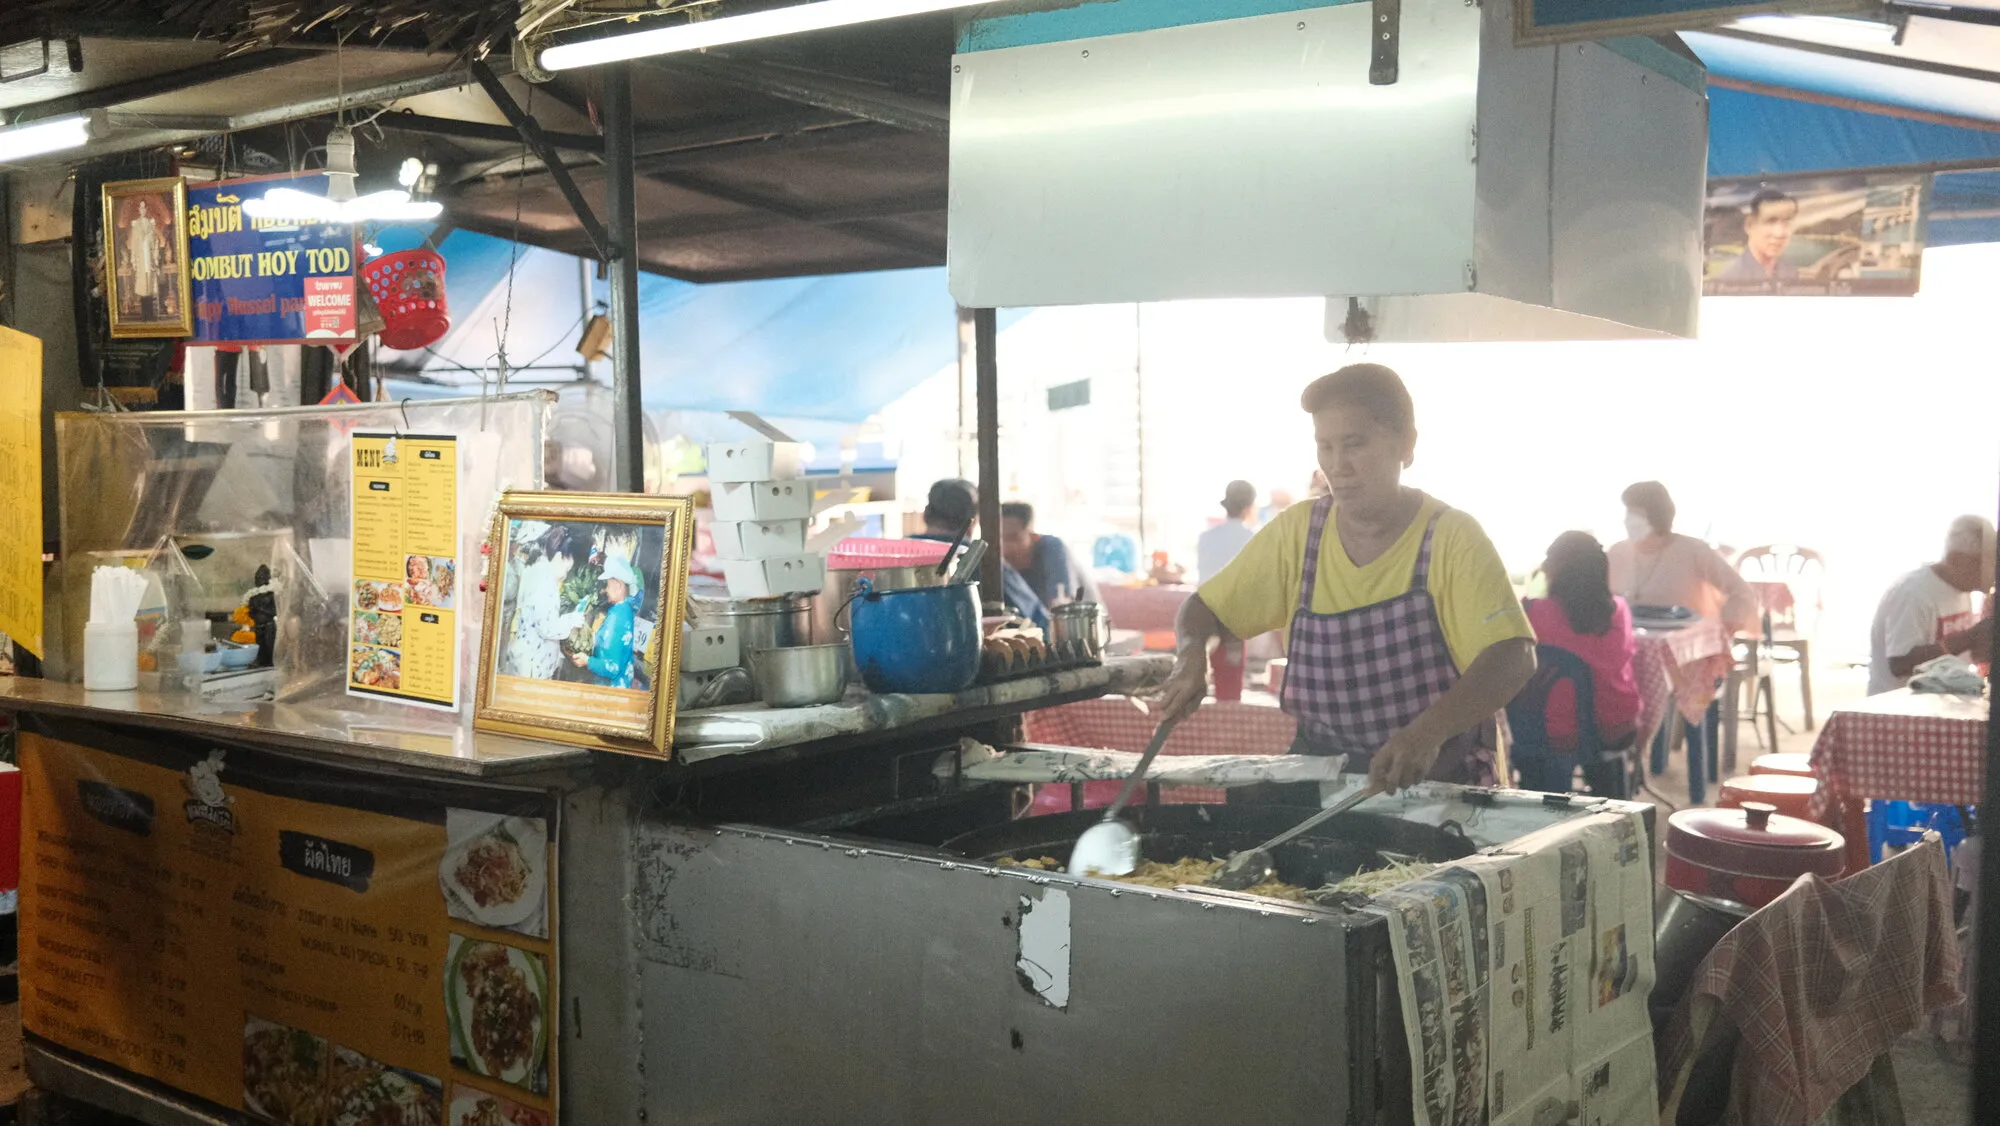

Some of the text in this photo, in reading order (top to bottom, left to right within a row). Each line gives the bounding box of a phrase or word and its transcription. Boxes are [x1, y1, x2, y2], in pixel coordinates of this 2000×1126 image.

[189, 193, 243, 240] สมบัติ
[257, 250, 300, 277] HOY
[306, 247, 351, 275] TOD
[307, 294, 352, 307] WELCOME
[357, 449, 381, 468] MENU
[304, 839, 352, 878] ผัดไทย
